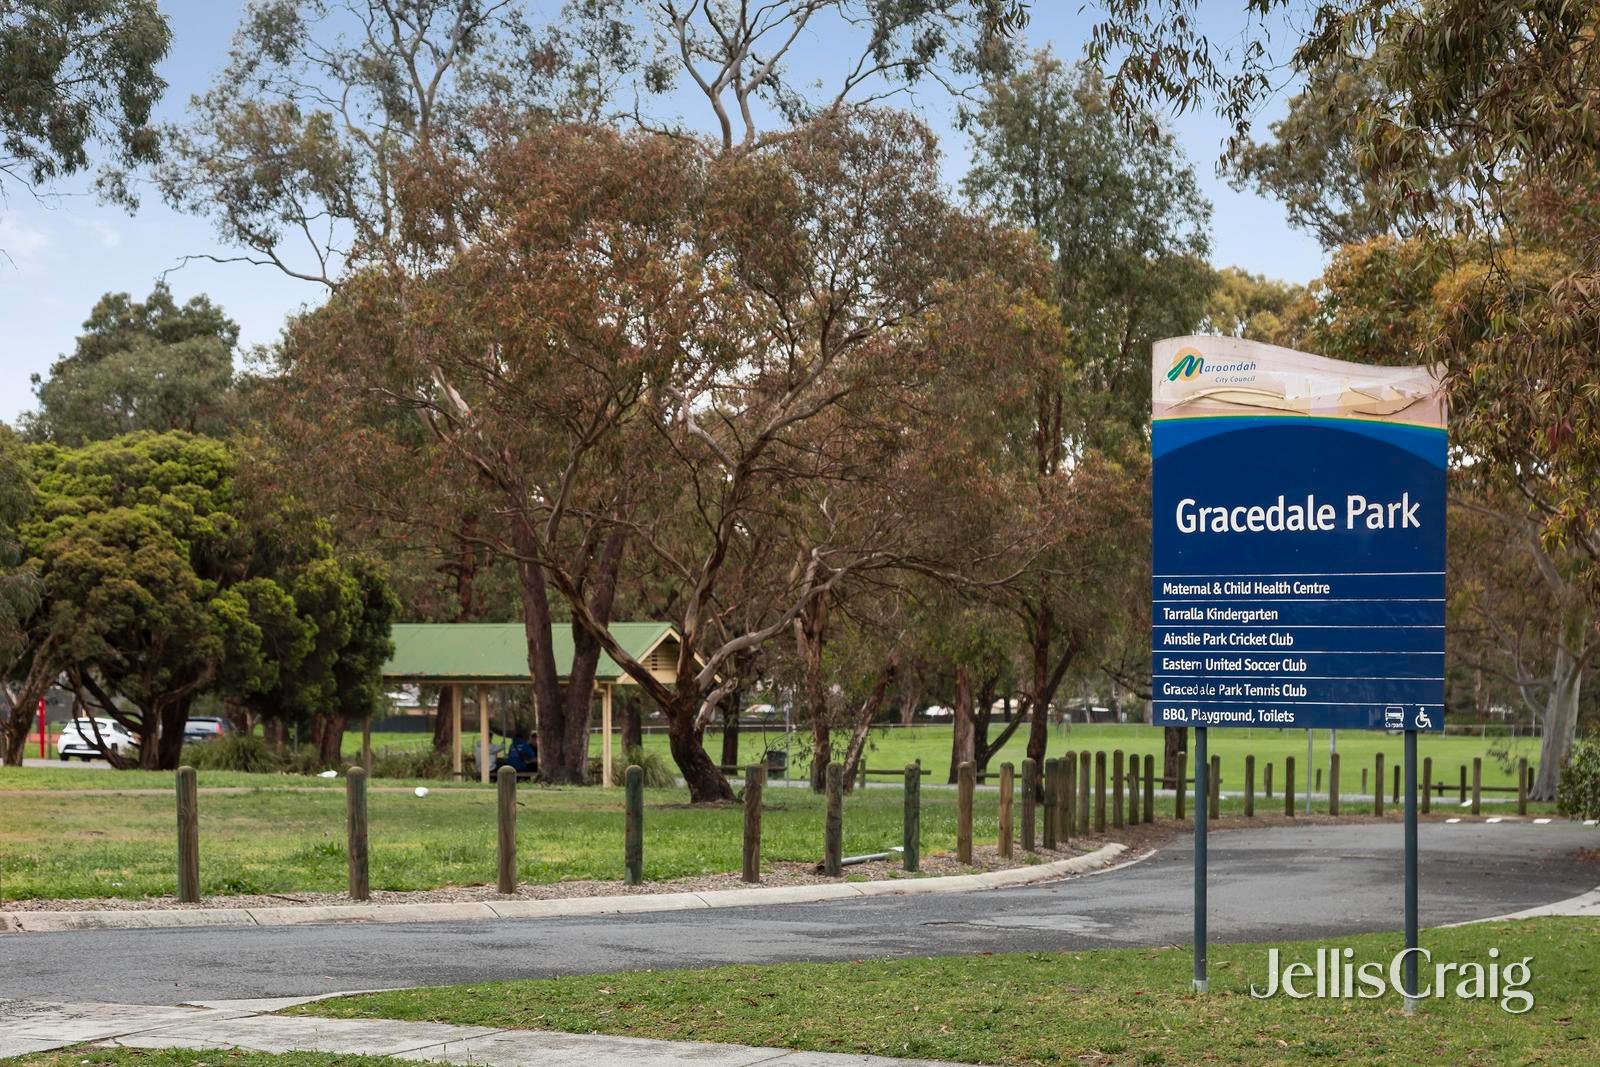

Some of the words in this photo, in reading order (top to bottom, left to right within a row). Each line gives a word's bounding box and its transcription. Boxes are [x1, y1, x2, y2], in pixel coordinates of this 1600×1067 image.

[1168, 354, 1257, 381] Maroondah
[1176, 495, 1336, 533] Gracedale
[1347, 492, 1421, 530] Park
[1163, 582, 1211, 595] Maternal
[1213, 582, 1222, 594] &
[1224, 582, 1250, 594] Child
[1254, 582, 1290, 594] Health
[1293, 582, 1330, 594] Centre
[1163, 608, 1203, 620] Tarralla
[1207, 608, 1278, 623] Kindergarten
[1163, 633, 1200, 645] Ainslie
[1203, 633, 1227, 645] Park
[1229, 633, 1267, 645] Cricket
[1269, 633, 1293, 646] Club
[1162, 658, 1202, 670] Eastern
[1206, 658, 1242, 670] United
[1244, 659, 1280, 671] Soccer
[1282, 659, 1307, 671] Club
[1163, 683, 1215, 695] Gracedale
[1219, 683, 1242, 696] Park
[1244, 684, 1280, 696] Tennis
[1282, 684, 1307, 697] Club
[1163, 709, 1188, 722] BBQ,
[1192, 709, 1256, 723] Playground,
[1258, 710, 1294, 722] Toilets
